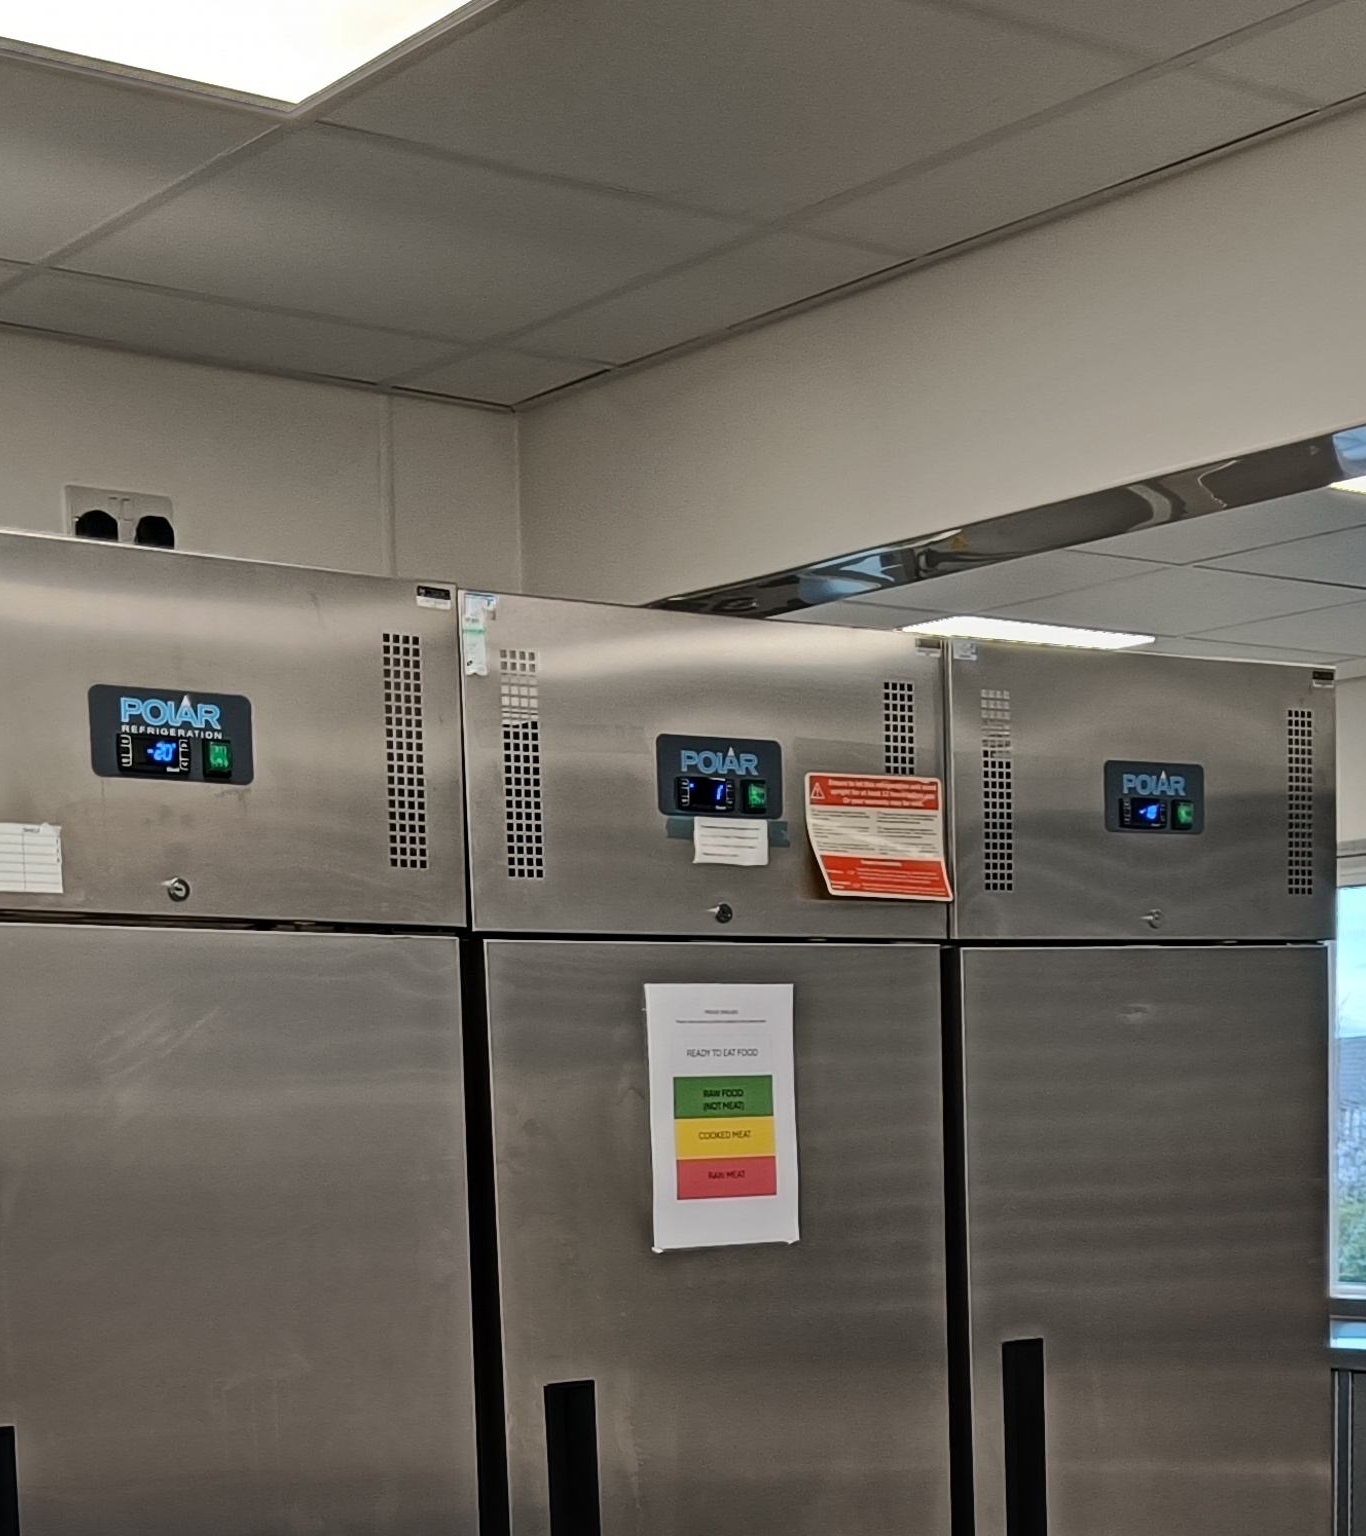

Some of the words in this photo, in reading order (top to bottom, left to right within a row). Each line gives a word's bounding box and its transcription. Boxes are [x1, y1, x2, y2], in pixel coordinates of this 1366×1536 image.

[120, 695, 222, 730] POLAR
[121, 725, 222, 739] REFRIGERATION
[680, 746, 759, 775] POLAR
[1122, 770, 1186, 796] POLAR
[686, 1048, 711, 1057] READY
[737, 1048, 759, 1057] FOOD
[703, 1089, 721, 1098] RAW
[721, 1088, 744, 1098] FOOD
[698, 1131, 731, 1140] COOKED
[732, 1130, 752, 1139] MEAT
[708, 1171, 725, 1179] RAW
[726, 1170, 746, 1179] MEAT
